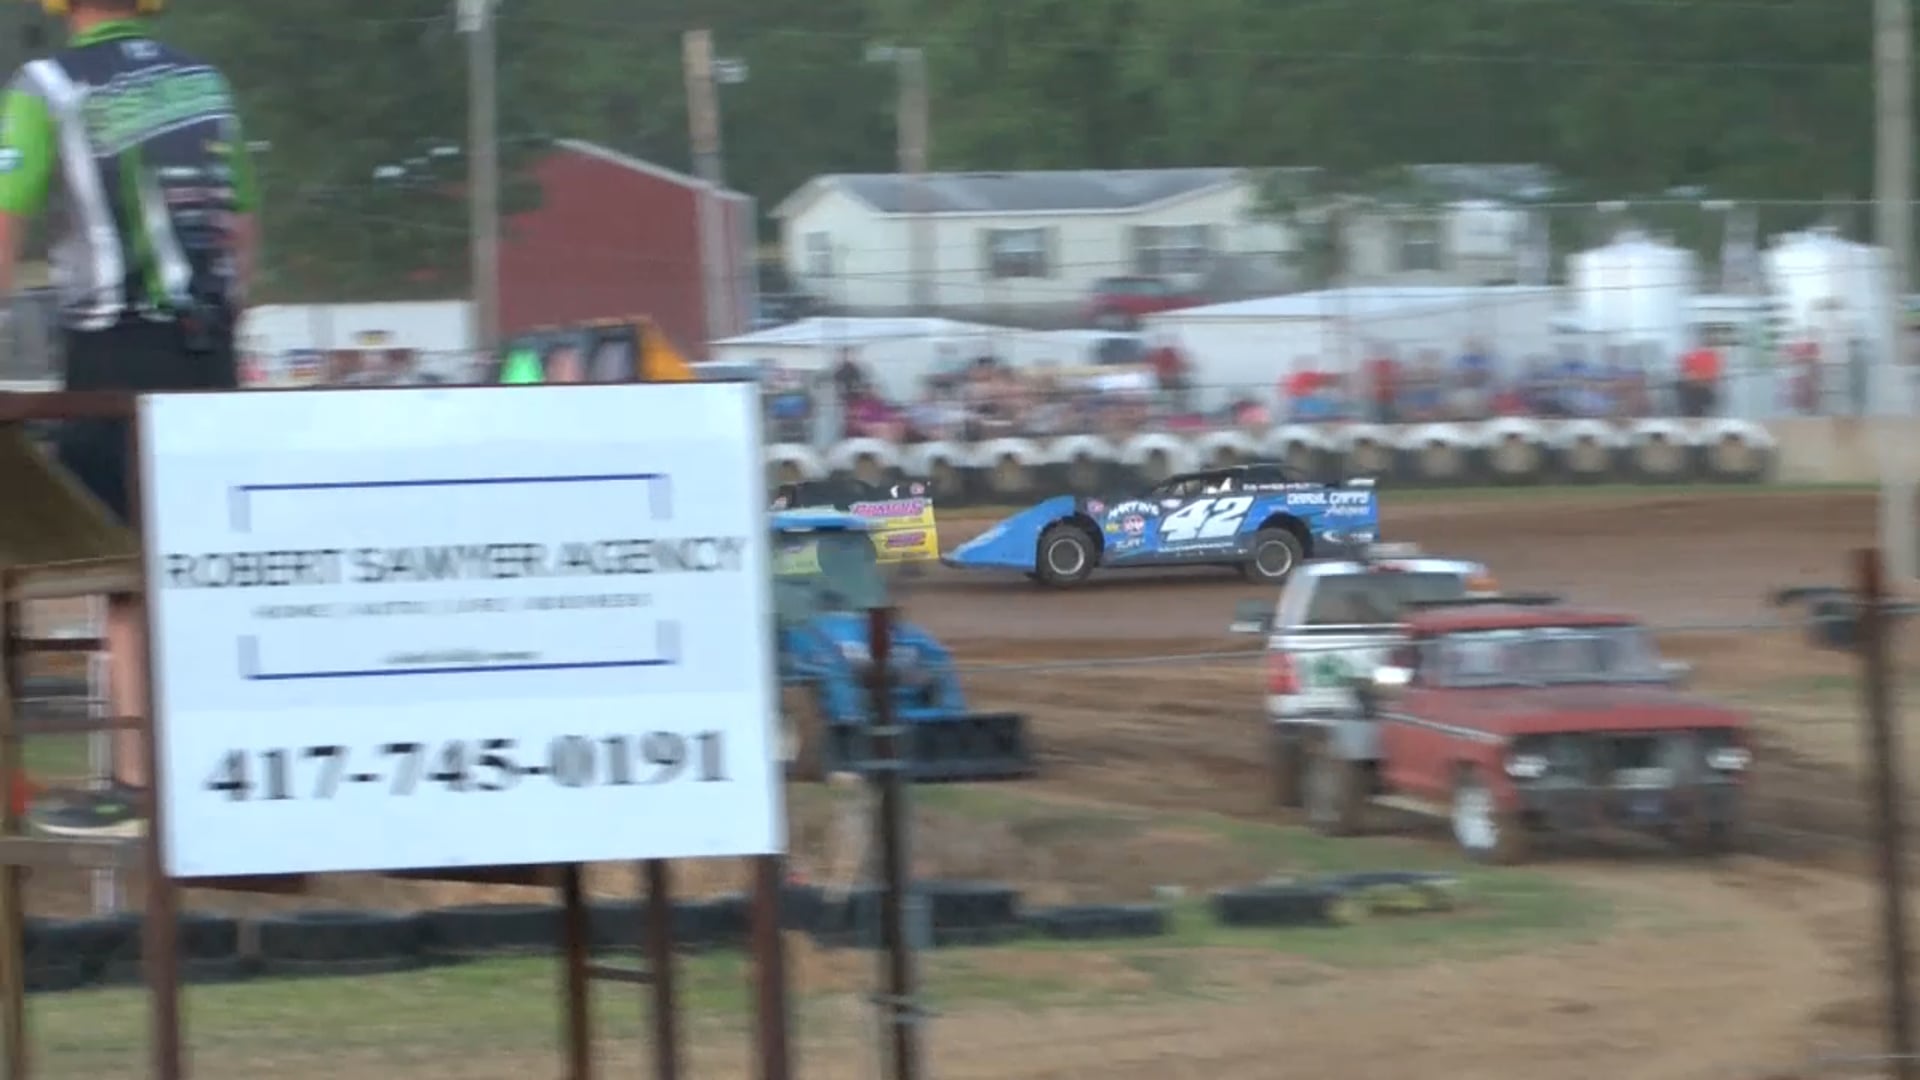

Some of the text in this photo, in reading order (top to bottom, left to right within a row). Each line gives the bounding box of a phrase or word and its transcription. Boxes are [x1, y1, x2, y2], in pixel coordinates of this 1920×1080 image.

[1159, 496, 1255, 543] 42
[163, 537, 748, 588] ROBERT SAWYER AGENCY
[201, 730, 733, 803] 417-745-0191
